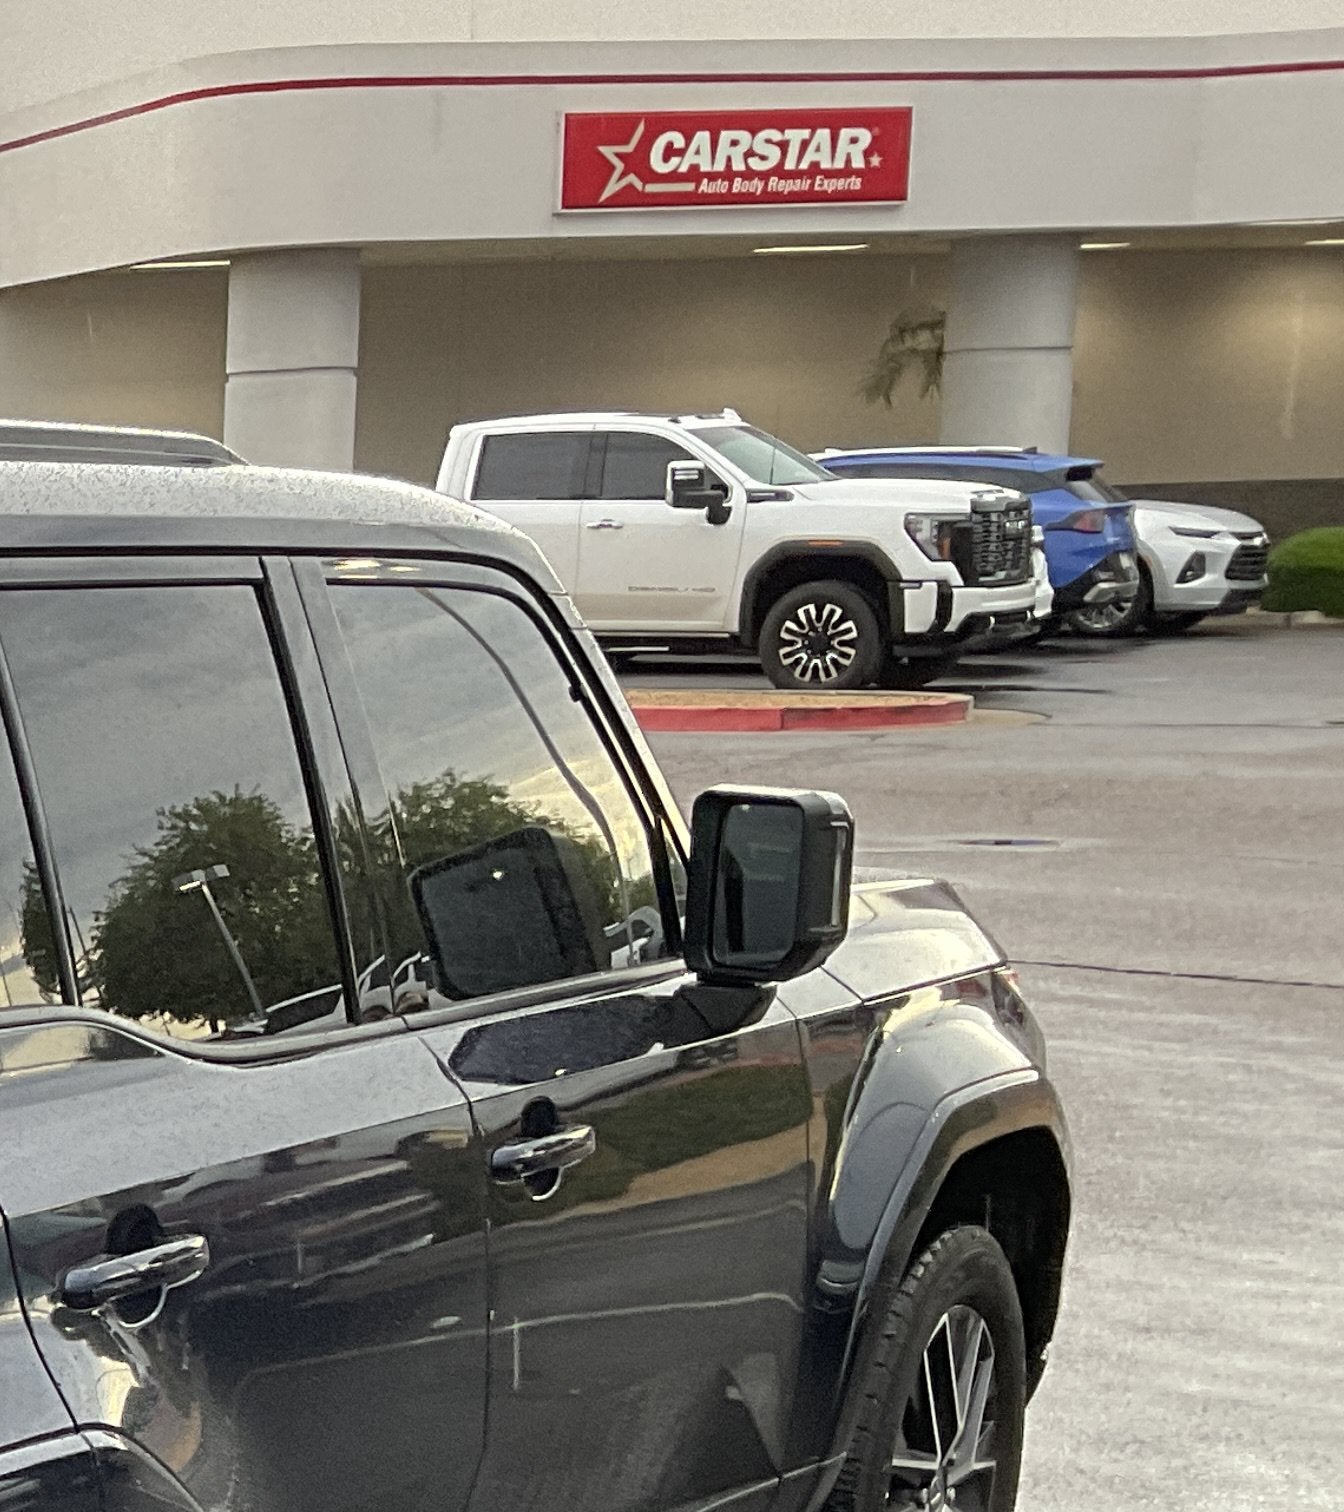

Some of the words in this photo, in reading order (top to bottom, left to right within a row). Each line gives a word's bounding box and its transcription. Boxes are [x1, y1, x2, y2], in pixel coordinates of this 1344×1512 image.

[649, 128, 871, 173] CARSTAR
[698, 178, 729, 194] Auto
[732, 177, 763, 195] Body
[767, 177, 811, 195] Repair
[814, 175, 862, 193] Experts
